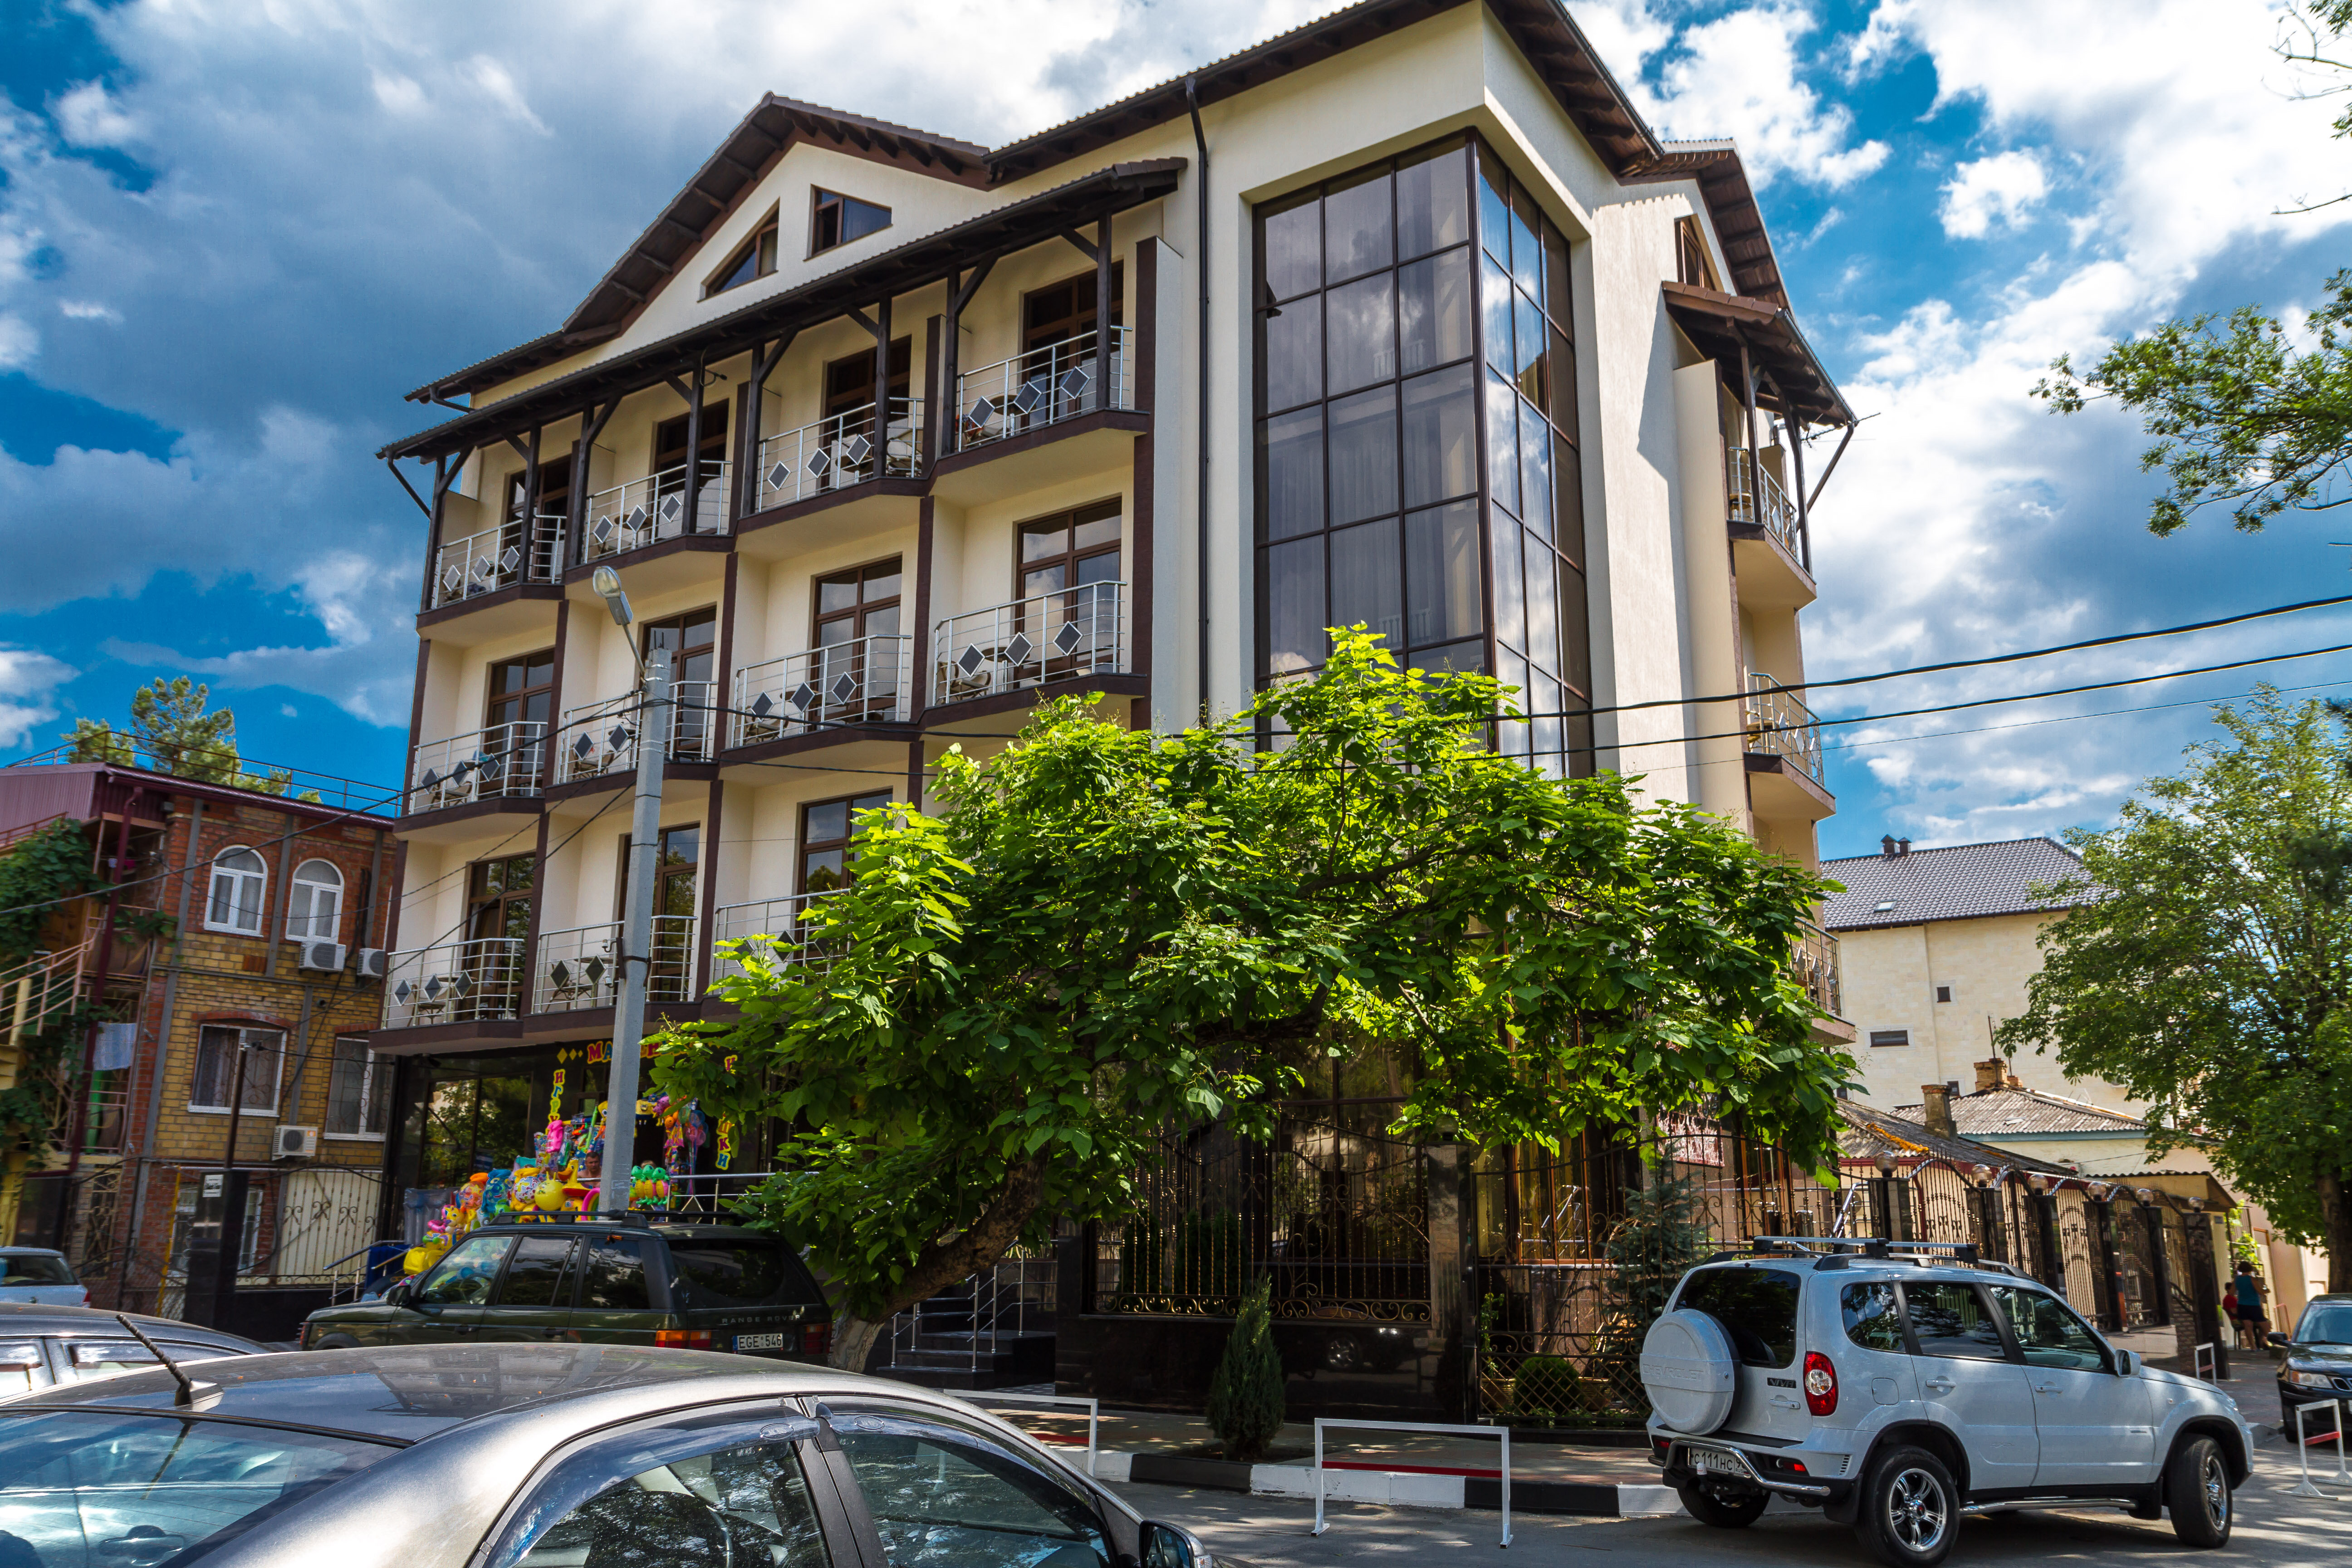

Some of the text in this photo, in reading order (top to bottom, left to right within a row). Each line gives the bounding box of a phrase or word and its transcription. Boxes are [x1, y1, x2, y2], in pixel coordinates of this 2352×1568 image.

[739, 1336, 760, 1349] EGE
[765, 1334, 782, 1347] 546
[1769, 1379, 1794, 1387] NIVA
